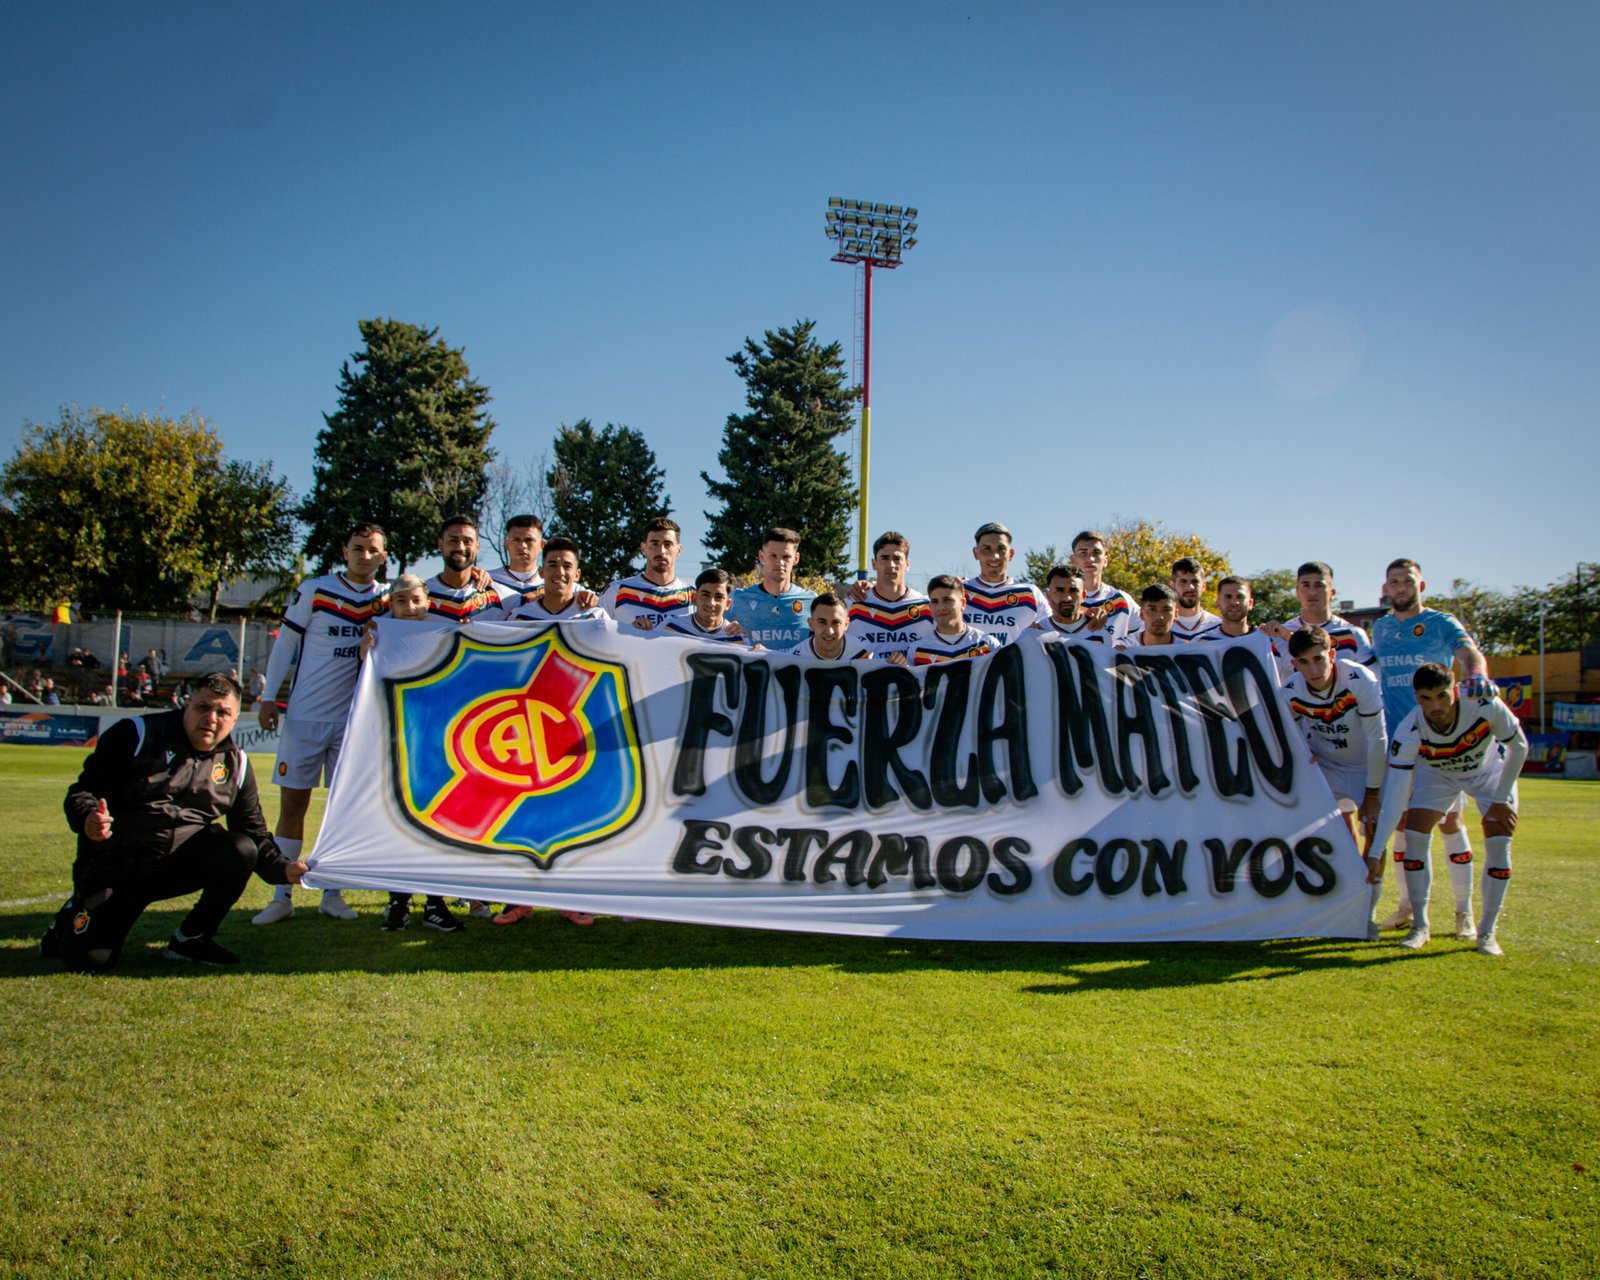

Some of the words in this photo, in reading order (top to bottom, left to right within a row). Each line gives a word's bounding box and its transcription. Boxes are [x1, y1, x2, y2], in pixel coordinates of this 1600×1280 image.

[328, 625, 363, 637] NEN
[673, 642, 1038, 810] FUERZA
[1044, 641, 1295, 799] MATEO
[672, 819, 1033, 895] ESTAMOS
[1053, 837, 1189, 897] CON
[1203, 837, 1337, 898] VOS
